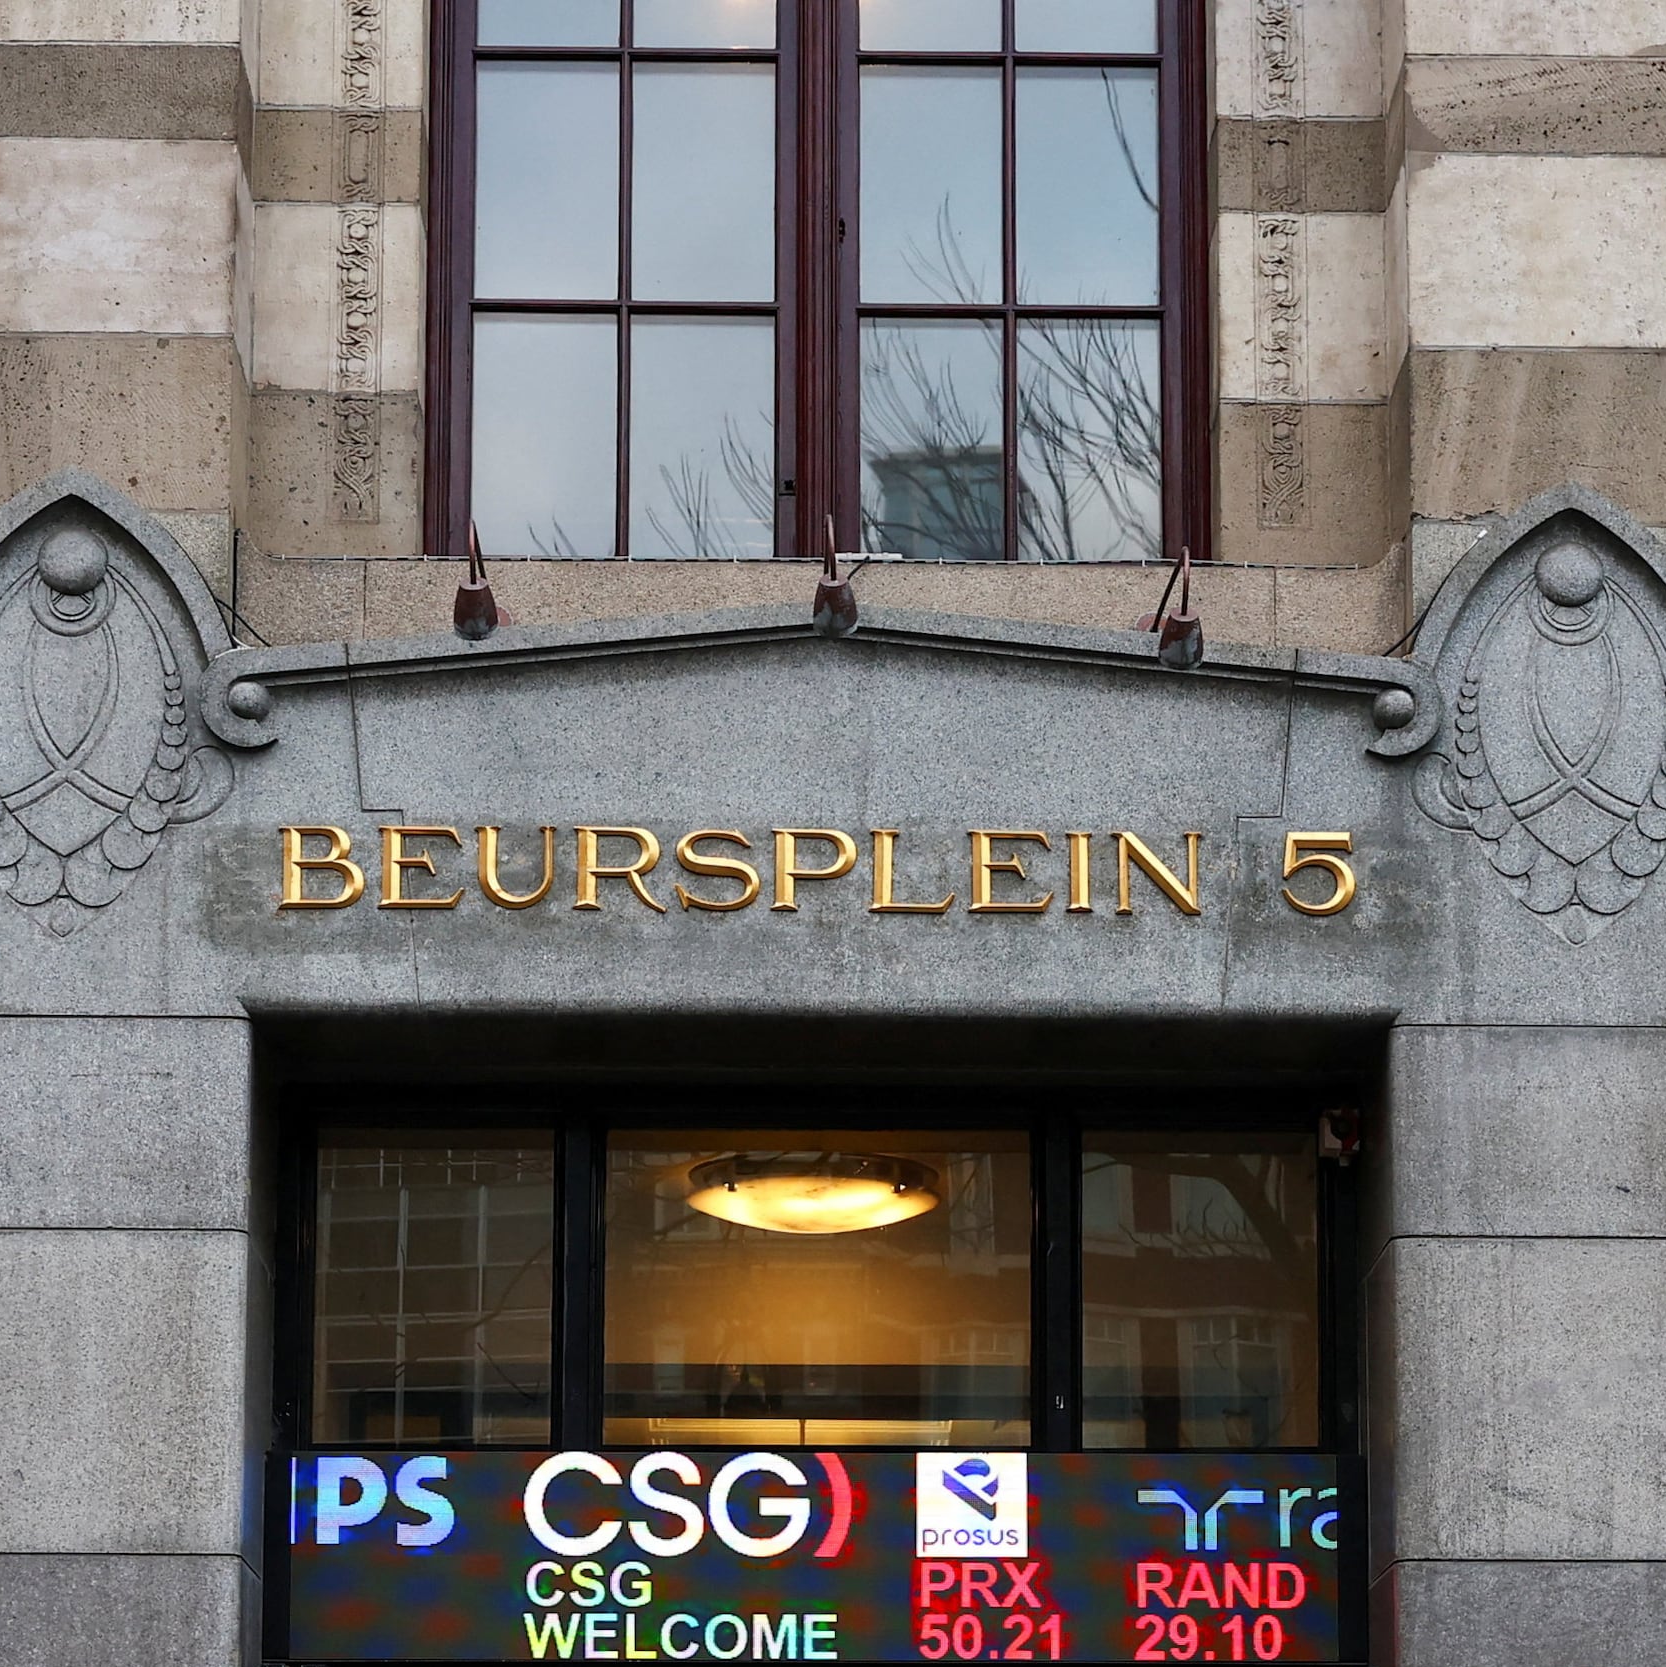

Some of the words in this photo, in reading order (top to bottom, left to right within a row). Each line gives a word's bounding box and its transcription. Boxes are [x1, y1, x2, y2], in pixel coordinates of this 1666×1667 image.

[278, 823, 1202, 916] BEURSPLEIN
[1282, 830, 1355, 916] 5
[292, 1456, 455, 1546] PS
[922, 1528, 1019, 1553] prosus
[525, 1561, 653, 1607] CSG
[920, 1562, 1042, 1608] PRX
[1136, 1562, 1307, 1609] RAND
[523, 1613, 838, 1660] WELCOME
[919, 1614, 1062, 1660] 50.21
[1134, 1614, 1283, 1661] 29.10
